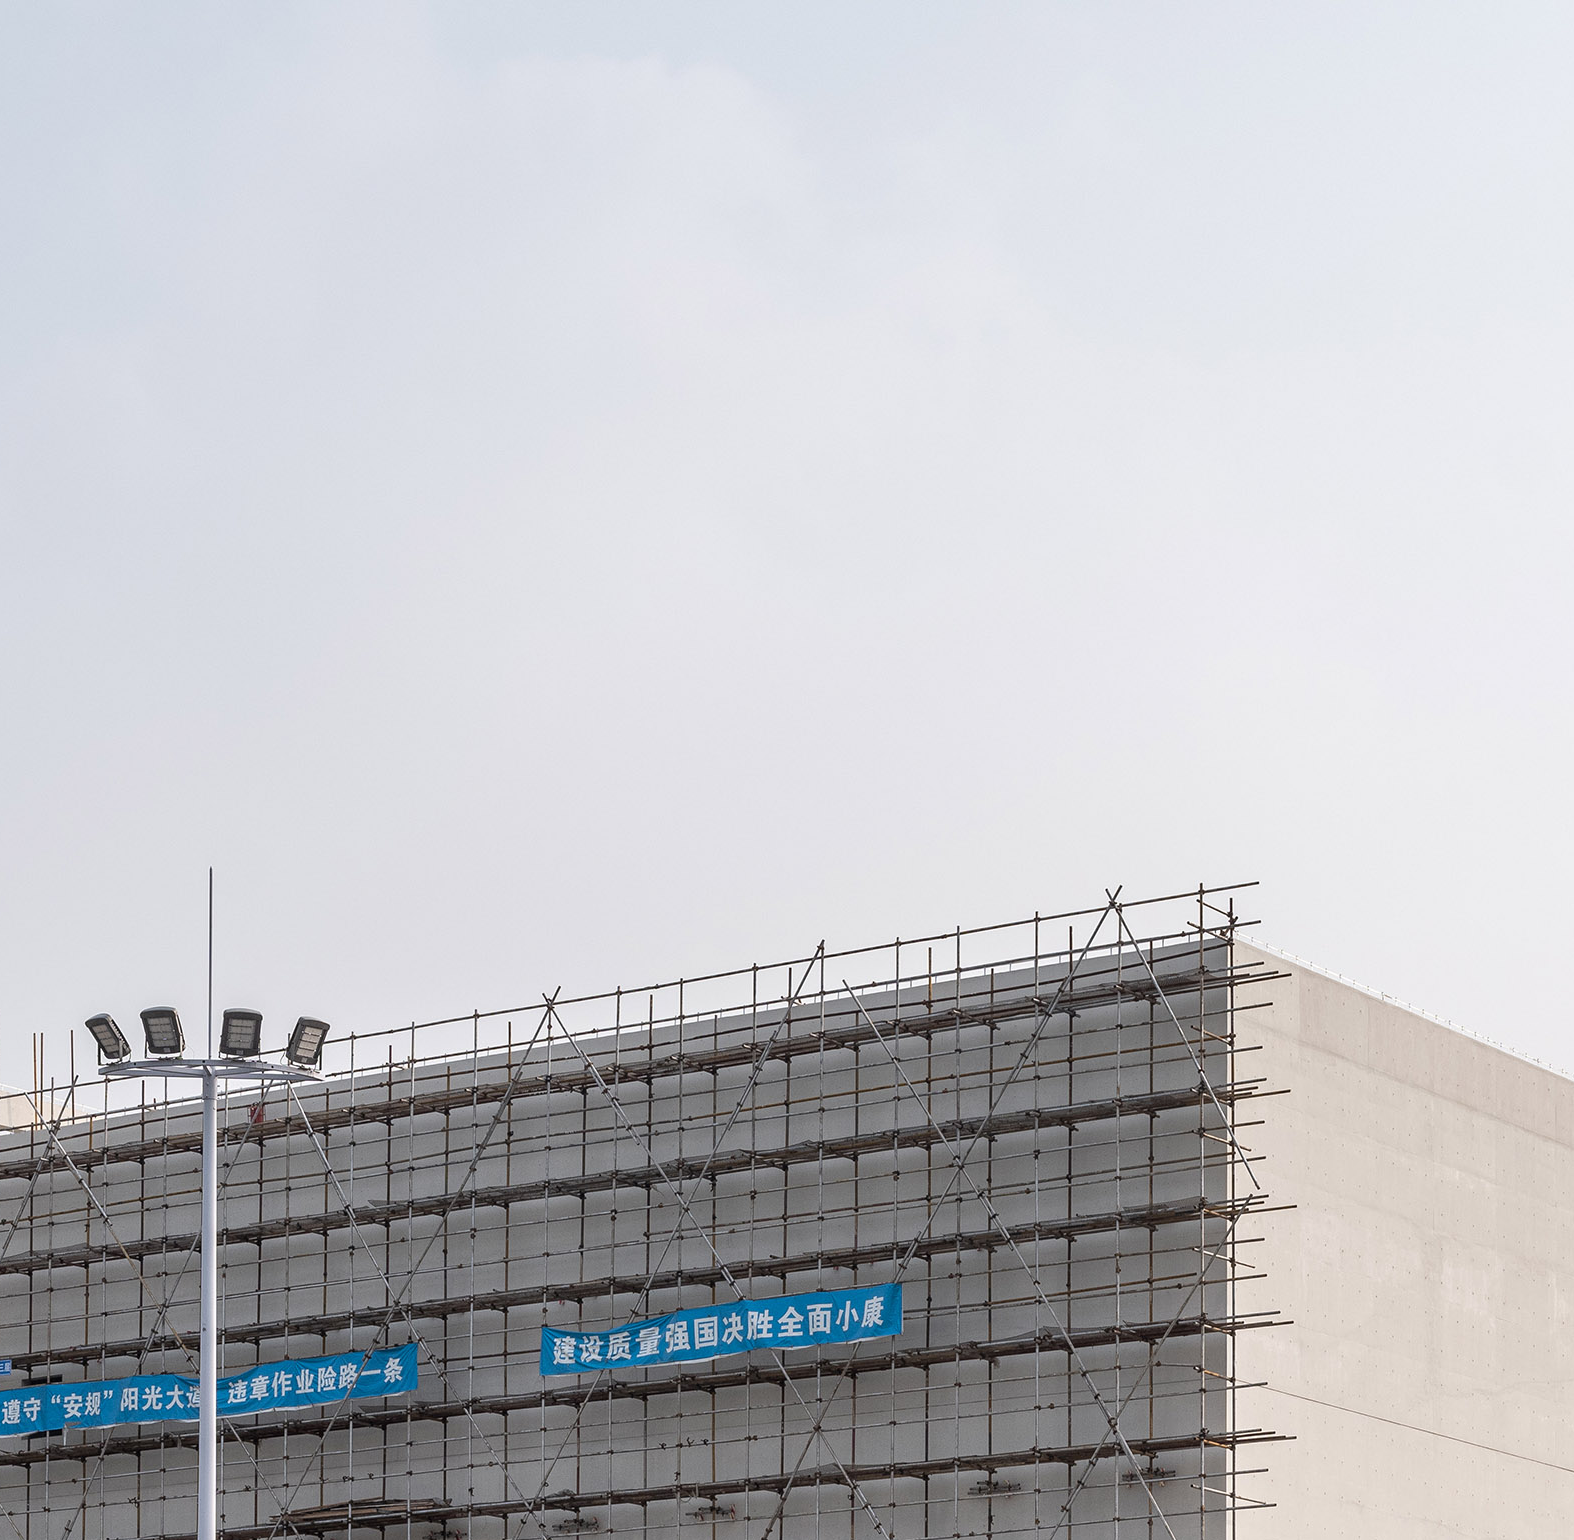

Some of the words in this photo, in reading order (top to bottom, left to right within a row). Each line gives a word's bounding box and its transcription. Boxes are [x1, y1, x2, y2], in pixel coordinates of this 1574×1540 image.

[552, 1295, 885, 1366] 建设质量强国决胜全面小康
[228, 1357, 404, 1404] 违章作业险路一条
